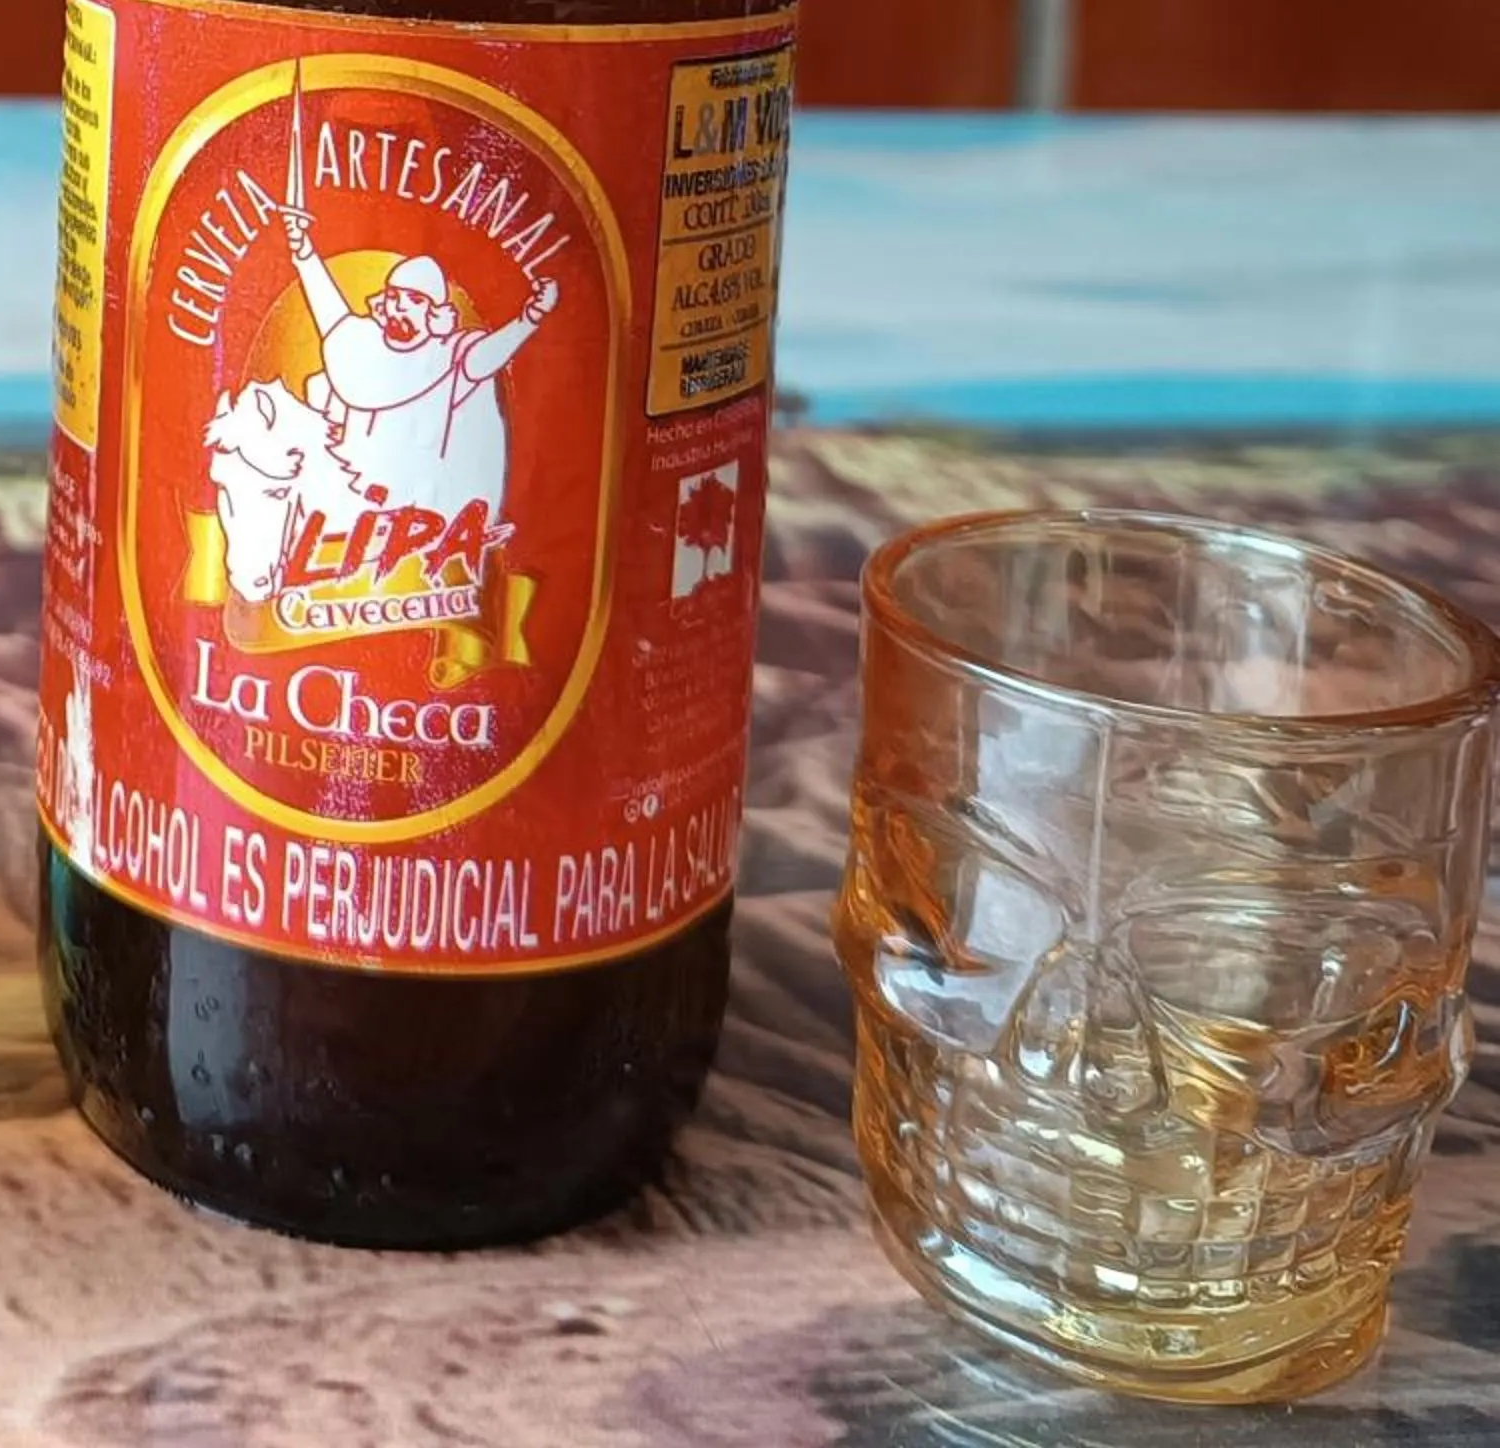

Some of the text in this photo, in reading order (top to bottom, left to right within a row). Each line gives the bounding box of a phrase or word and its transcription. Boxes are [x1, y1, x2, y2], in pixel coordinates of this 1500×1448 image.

[169, 168, 278, 347] CERVEZA
[314, 121, 570, 281] ARTESANAL
[698, 233, 756, 271] GRADO
[191, 638, 271, 721] La
[286, 663, 497, 747] Checa
[85, 762, 208, 908] LCOHOL
[222, 827, 266, 925] ES
[281, 840, 540, 951] PERJUDICIAL
[554, 854, 637, 943] PARA
[646, 826, 676, 921] LA
